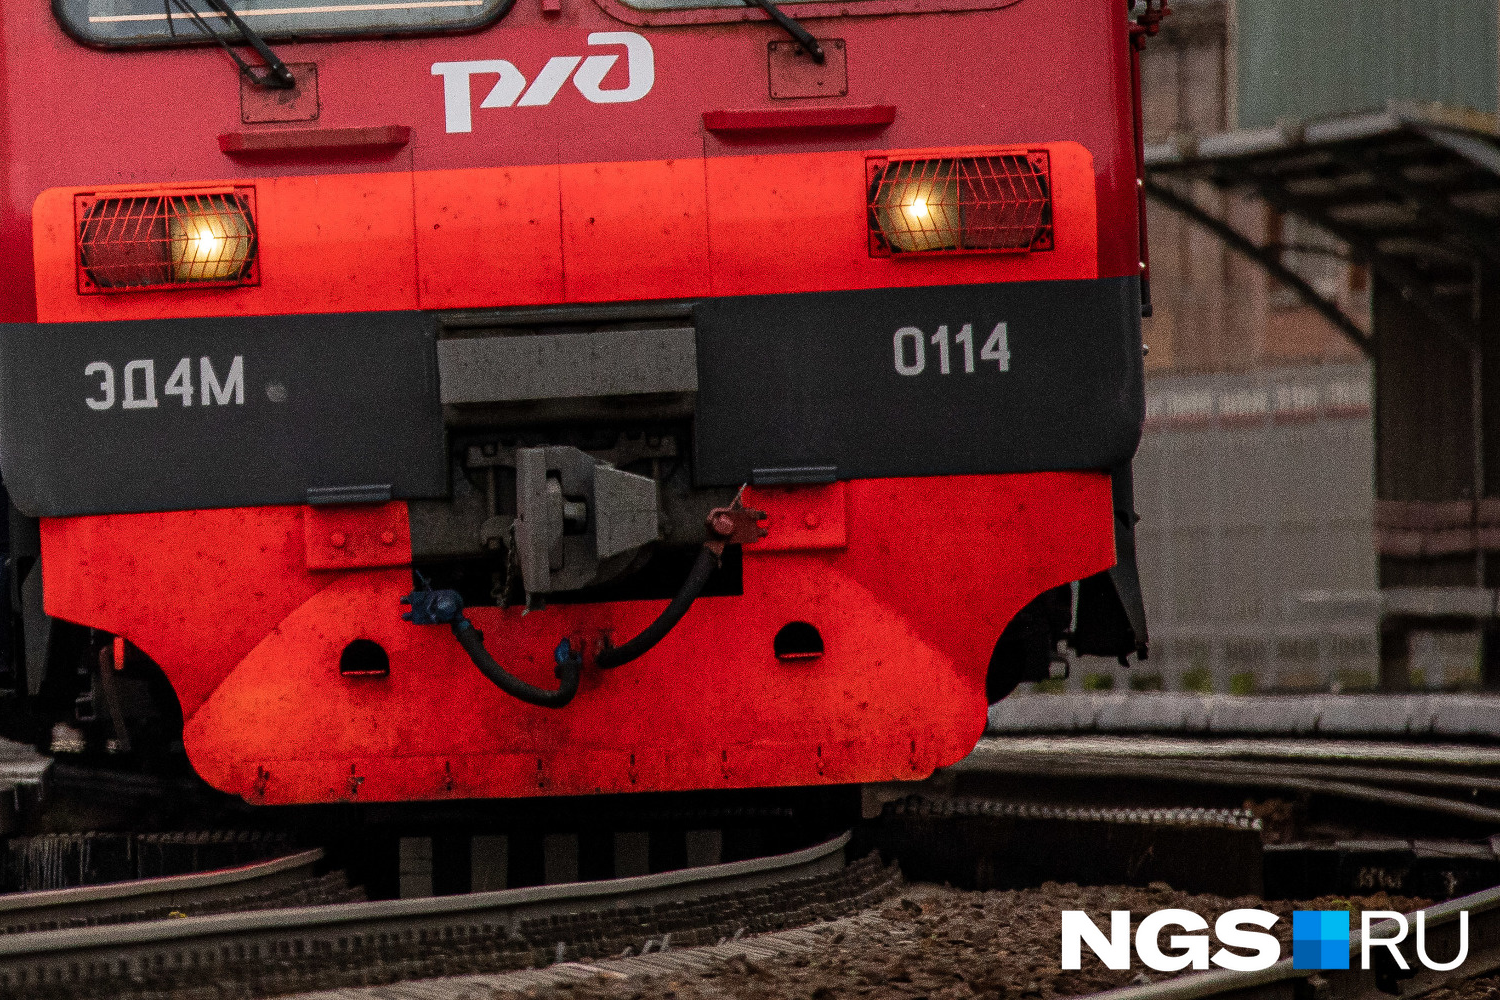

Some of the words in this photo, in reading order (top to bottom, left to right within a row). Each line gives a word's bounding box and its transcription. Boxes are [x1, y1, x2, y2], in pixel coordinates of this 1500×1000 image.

[431, 32, 655, 133] РЖД
[893, 322, 1010, 376] 0114
[85, 355, 244, 410] ЭД4М
